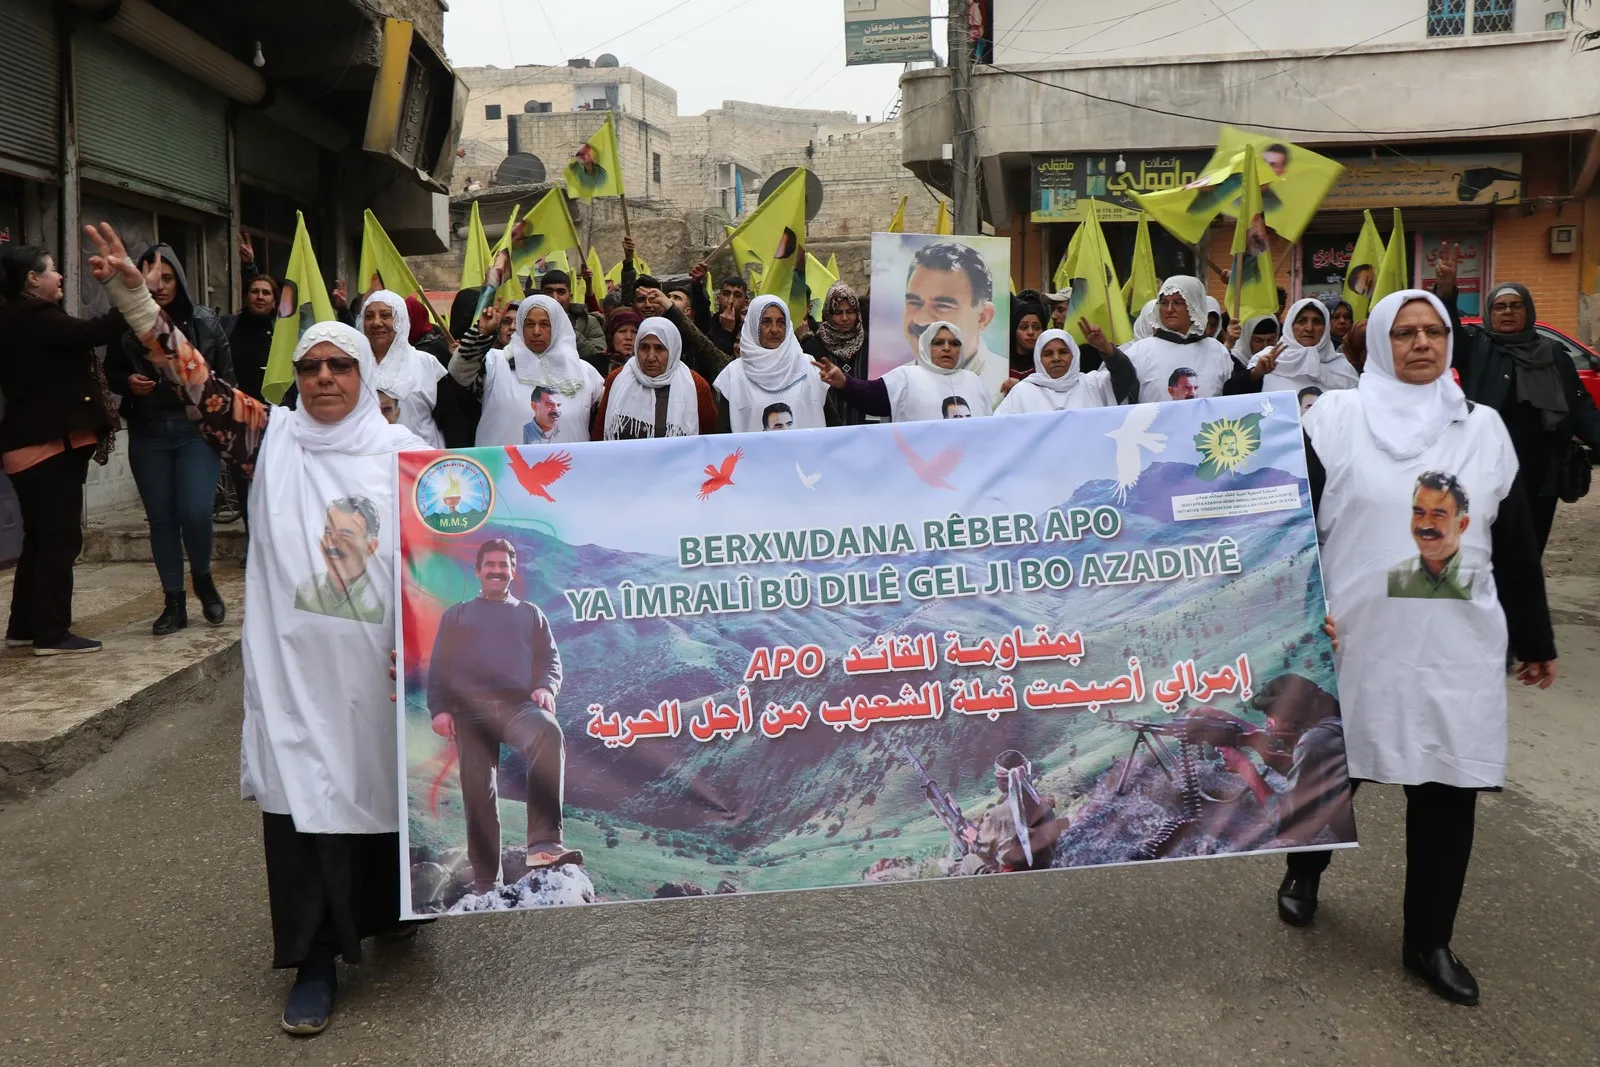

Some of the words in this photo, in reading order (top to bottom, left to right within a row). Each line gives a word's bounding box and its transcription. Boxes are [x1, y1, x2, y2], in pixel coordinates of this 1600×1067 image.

[902, 18, 930, 29] مكتب
[439, 517, 468, 528] M.M.Ş
[679, 522, 916, 567] BERXWDANA
[922, 513, 1037, 549] RÊBER
[1045, 507, 1121, 541] APO
[566, 590, 615, 621] YA
[620, 574, 752, 618] ÎMRALÎ
[759, 571, 810, 609] BÛ
[819, 565, 899, 605] DILÊ
[907, 566, 977, 598] GEL
[983, 561, 1011, 592] JI
[1021, 556, 1072, 590] BO
[1080, 537, 1241, 586] AZADIYÊ
[745, 645, 825, 680] APO
[844, 633, 936, 674] القائد
[945, 625, 1084, 669] بمقاومة
[819, 681, 942, 732] الشعوب
[951, 675, 1017, 721] قبلة
[1024, 657, 1145, 712] أصبحت
[1153, 654, 1252, 712] إمرالي
[586, 699, 680, 748] الحرية
[689, 687, 752, 741] أجل
[760, 701, 811, 737] من
